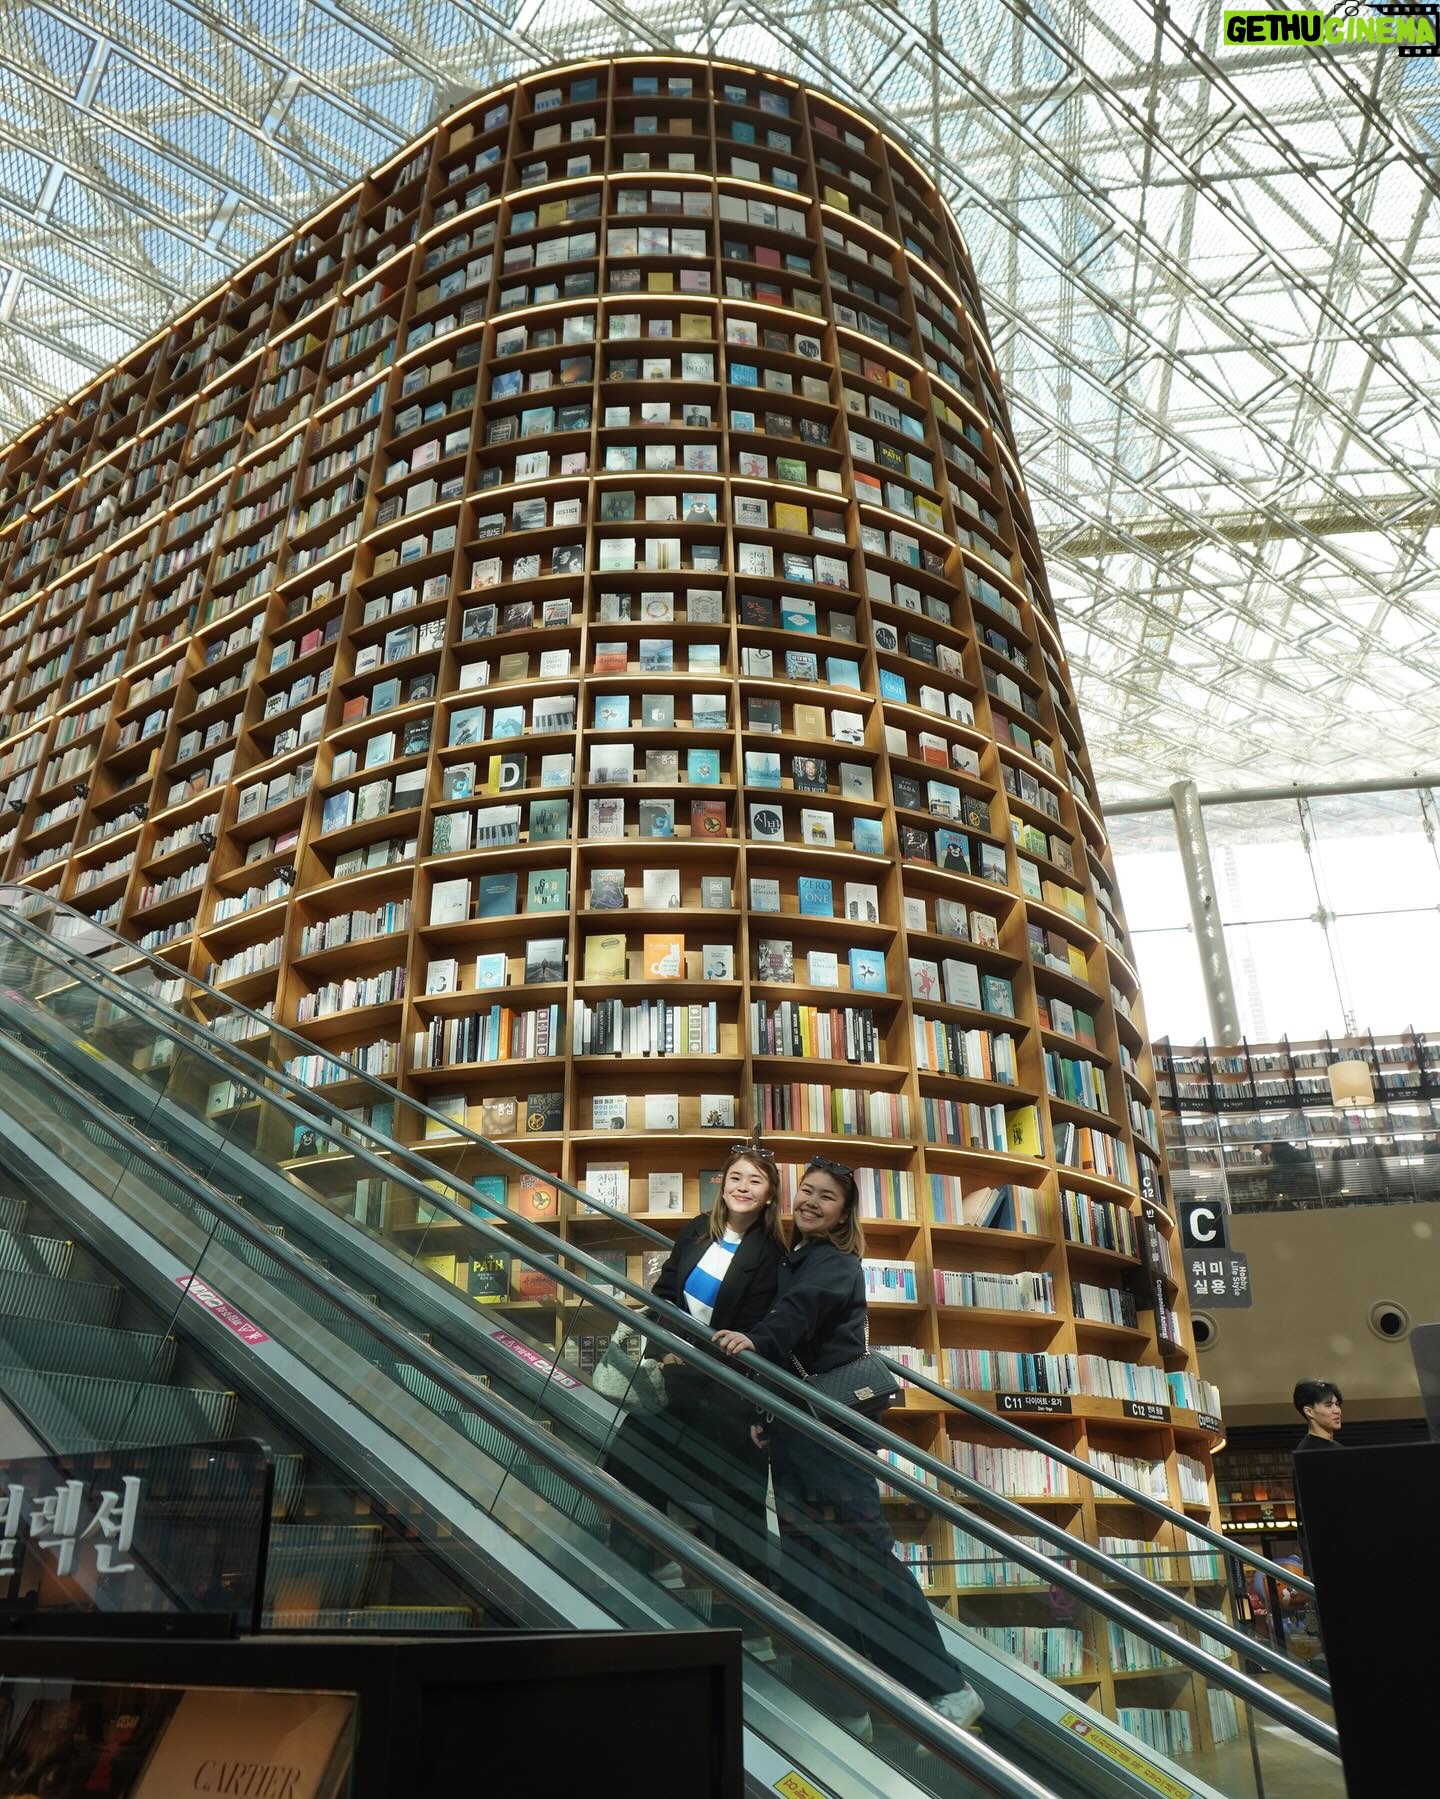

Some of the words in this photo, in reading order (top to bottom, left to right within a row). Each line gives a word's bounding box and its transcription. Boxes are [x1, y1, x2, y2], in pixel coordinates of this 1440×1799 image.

[501, 762, 520, 788] D
[803, 880, 831, 890] ZERO
[805, 893, 829, 904] ONE
[1143, 1176, 1151, 1187] C
[1142, 1188, 1154, 1198] 12
[1189, 1207, 1217, 1242] C
[473, 1259, 504, 1272] PATH
[1192, 1260, 1224, 1276] 취미
[1231, 1261, 1239, 1275] Life
[1194, 1278, 1226, 1296] 실용
[1231, 1276, 1241, 1296] Style
[1004, 1395, 1022, 1409] C11
[1132, 1403, 1145, 1416] C12
[194, 1759, 301, 1799] CARTIER
